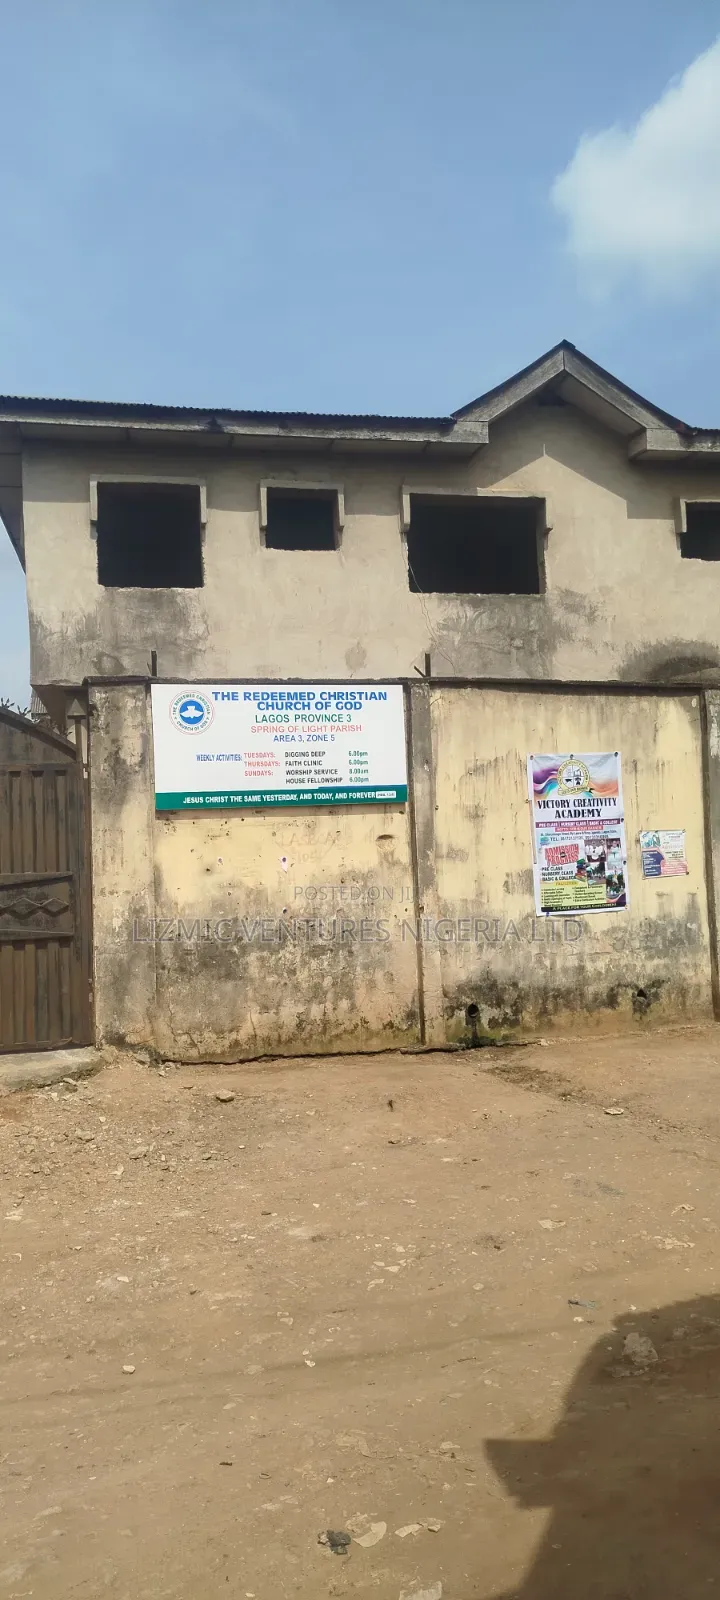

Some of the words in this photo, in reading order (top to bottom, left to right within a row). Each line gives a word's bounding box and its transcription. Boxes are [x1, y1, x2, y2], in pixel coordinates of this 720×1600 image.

[212, 691, 239, 701] THE
[243, 691, 316, 701] REDEEMED
[319, 691, 388, 701] CHRISTIAN
[256, 701, 311, 711] CHURCH
[314, 701, 332, 711] OF
[335, 701, 363, 711] GOD
[255, 714, 290, 724] LAGOS
[294, 713, 344, 723] PROVINCE
[346, 713, 352, 723] 3
[251, 725, 285, 734] SPRING
[287, 725, 300, 733] OF
[302, 725, 327, 733] LIGHT
[330, 724, 362, 733] PARISH
[273, 735, 296, 743] AREA
[297, 735, 305, 743] 3,
[306, 734, 329, 743] ZONE
[330, 734, 336, 742] 5
[196, 753, 215, 762] WEEKLY
[215, 753, 243, 762] ACTIVITIES:
[243, 751, 276, 759] TUESDAYS:
[310, 750, 326, 758] DEEP
[303, 759, 323, 767] CLINIC
[244, 769, 274, 777] SUNDAYS:
[285, 777, 306, 785] HOUSE
[307, 776, 343, 784] FELLOWSHIP
[349, 776, 370, 784] 6.00pm
[182, 796, 204, 804] JESUS
[205, 795, 229, 804] CHRIST
[229, 795, 243, 803] THE
[243, 794, 262, 803] SAME
[262, 793, 299, 802] YESTERDAY,
[313, 793, 334, 801] TODAY,
[348, 791, 376, 799] FOREVER
[537, 799, 571, 810] VICTORY
[573, 797, 617, 808] CREATIVITY
[554, 808, 602, 819] ACADEMY
